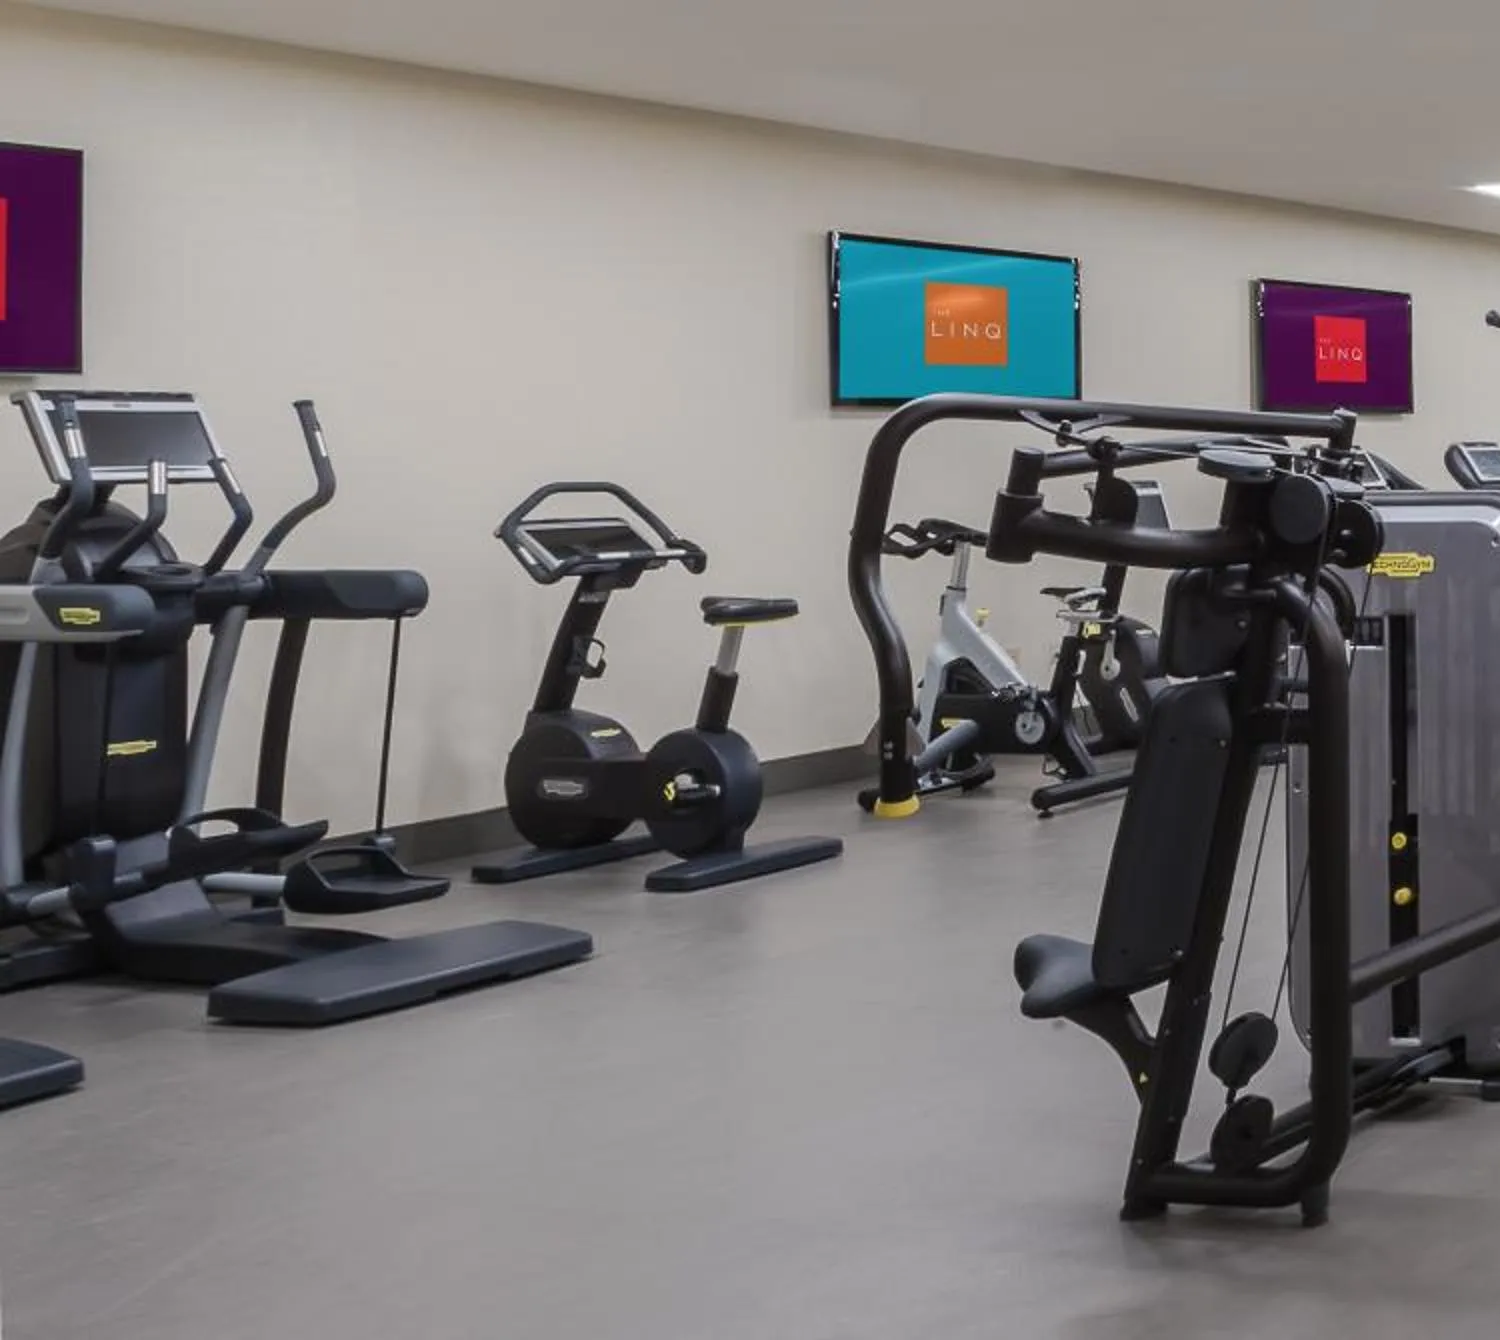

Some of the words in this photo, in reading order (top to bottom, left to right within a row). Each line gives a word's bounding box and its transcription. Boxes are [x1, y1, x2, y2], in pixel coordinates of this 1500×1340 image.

[931, 319, 1002, 340] LINQ
[1319, 346, 1363, 361] LINQ
[1371, 555, 1432, 574] ECHNOGYM
